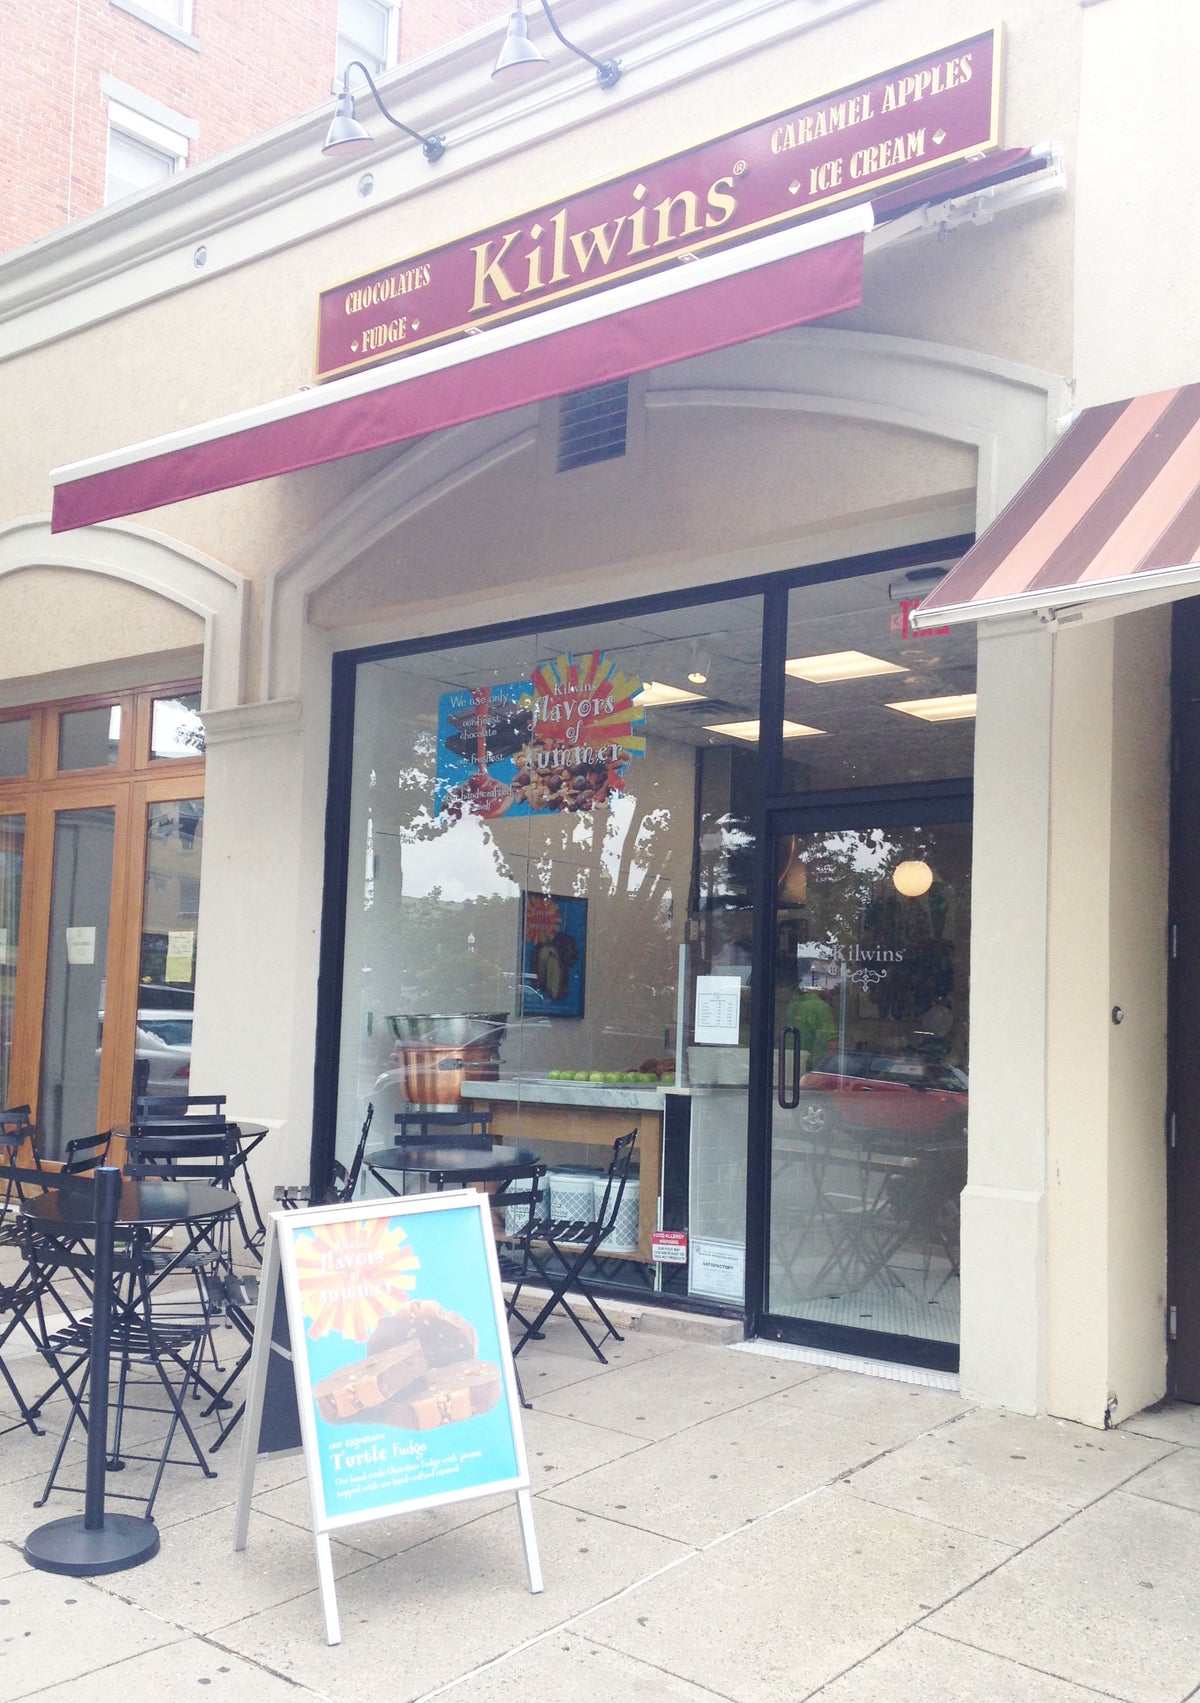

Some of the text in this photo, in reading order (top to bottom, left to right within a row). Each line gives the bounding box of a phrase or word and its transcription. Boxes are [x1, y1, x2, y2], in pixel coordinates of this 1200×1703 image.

[771, 53, 973, 155] CARAMEL APPLES
[808, 127, 927, 195] ICE CREAM
[345, 263, 431, 315] CHOCOLATES
[361, 316, 407, 353] FUDGE
[450, 689, 509, 708] We use only
[554, 682, 597, 696] Kilwins
[527, 694, 616, 732] flavors
[459, 728, 497, 740] chocolate
[565, 720, 584, 743] of
[525, 743, 623, 770] summer
[831, 944, 904, 962] Kilwins
[320, 1250, 385, 1277] flavors
[350, 1268, 361, 1281] of
[703, 1261, 734, 1270] SATISFACTORY
[320, 1280, 394, 1304] summer
[329, 1440, 428, 1471] Turtle Fudge
